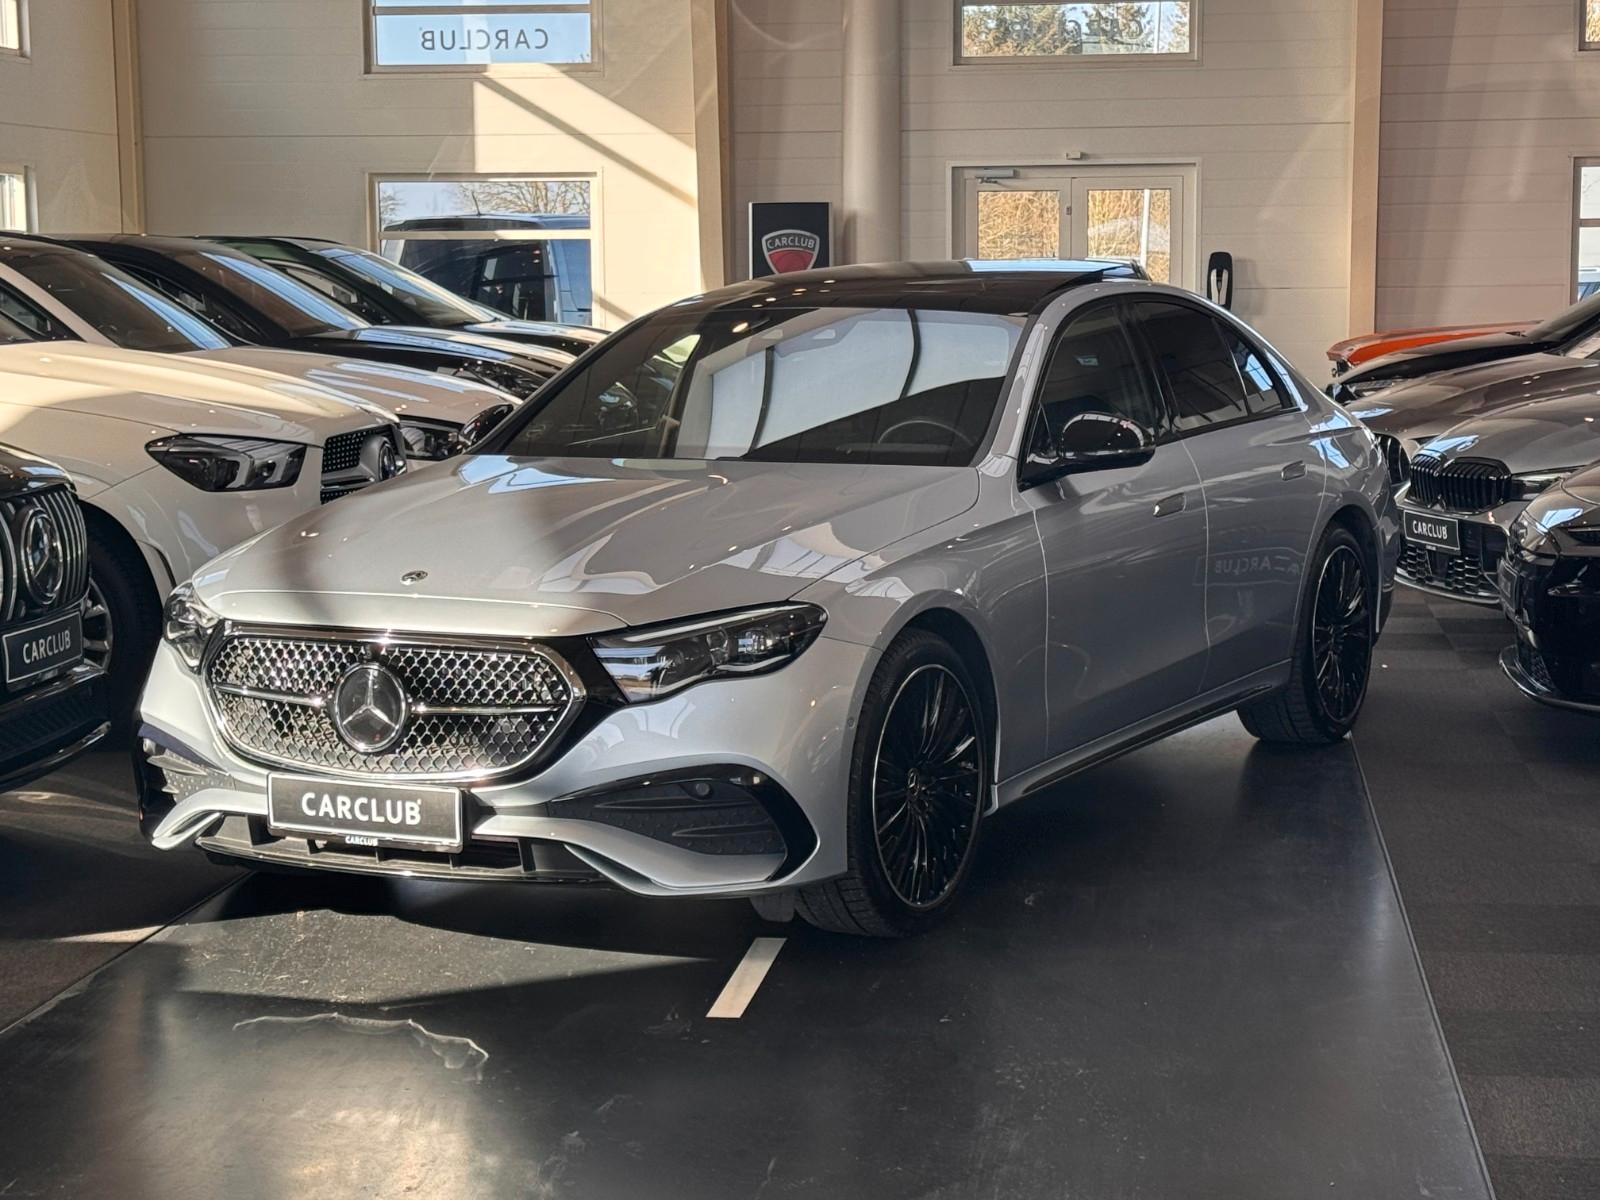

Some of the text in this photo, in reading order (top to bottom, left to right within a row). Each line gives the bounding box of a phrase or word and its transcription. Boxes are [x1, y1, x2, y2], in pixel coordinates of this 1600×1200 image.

[766, 236, 816, 249] CARCLUB
[1413, 520, 1448, 540] CARCLUB
[22, 630, 71, 664] CARCLUB
[301, 792, 421, 825] CARCLUB
